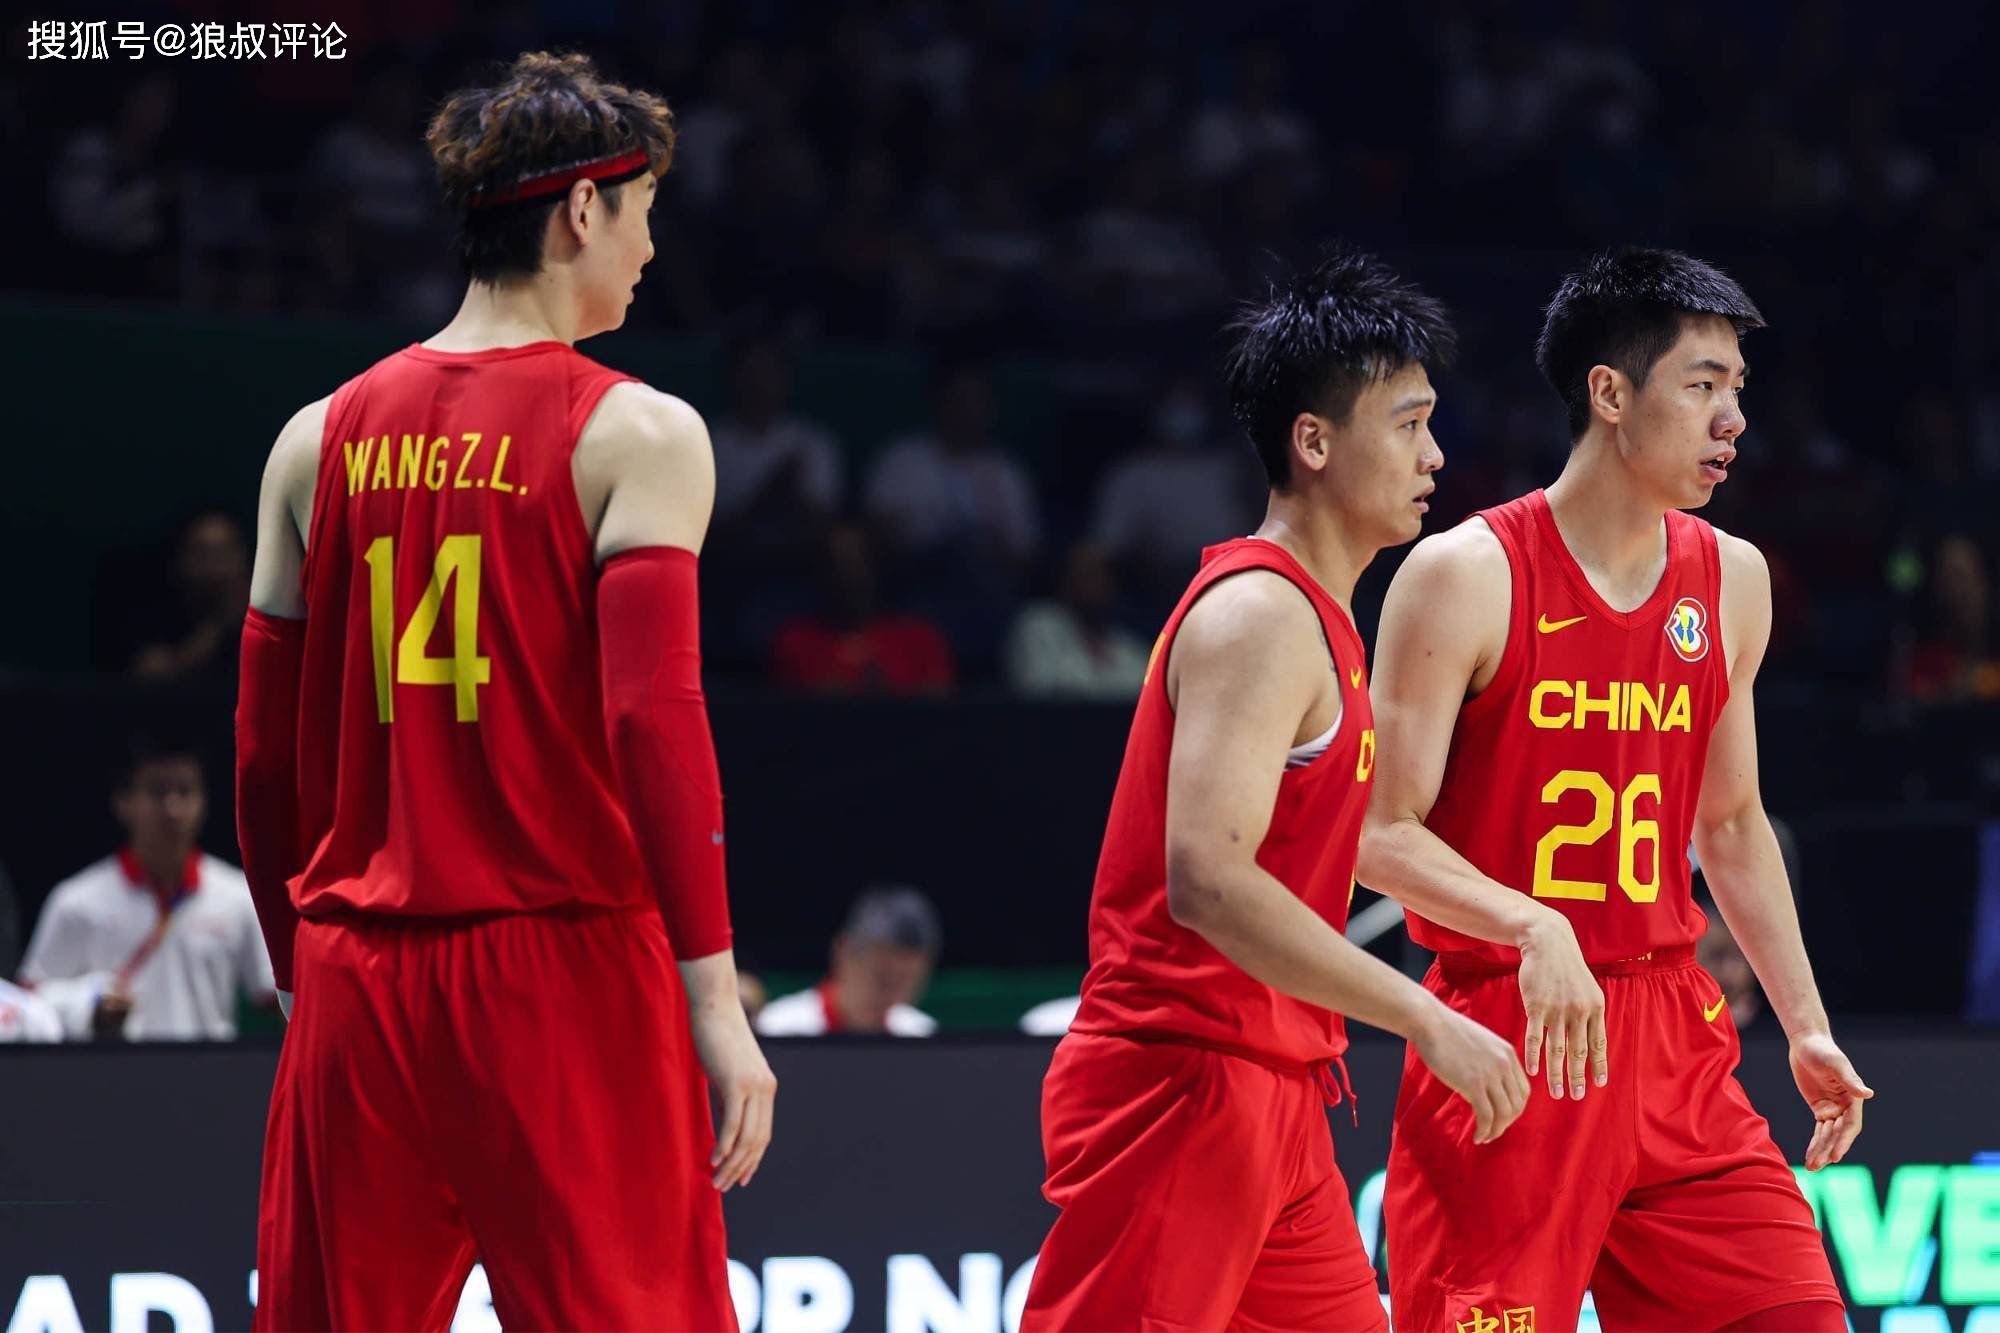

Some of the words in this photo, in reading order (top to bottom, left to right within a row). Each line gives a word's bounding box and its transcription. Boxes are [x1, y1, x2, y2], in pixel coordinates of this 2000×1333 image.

[364, 535, 490, 724] 14
[1529, 680, 1691, 733] CHINA
[1532, 769, 1662, 903] 26
[1791, 1165, 2000, 1306] VE
